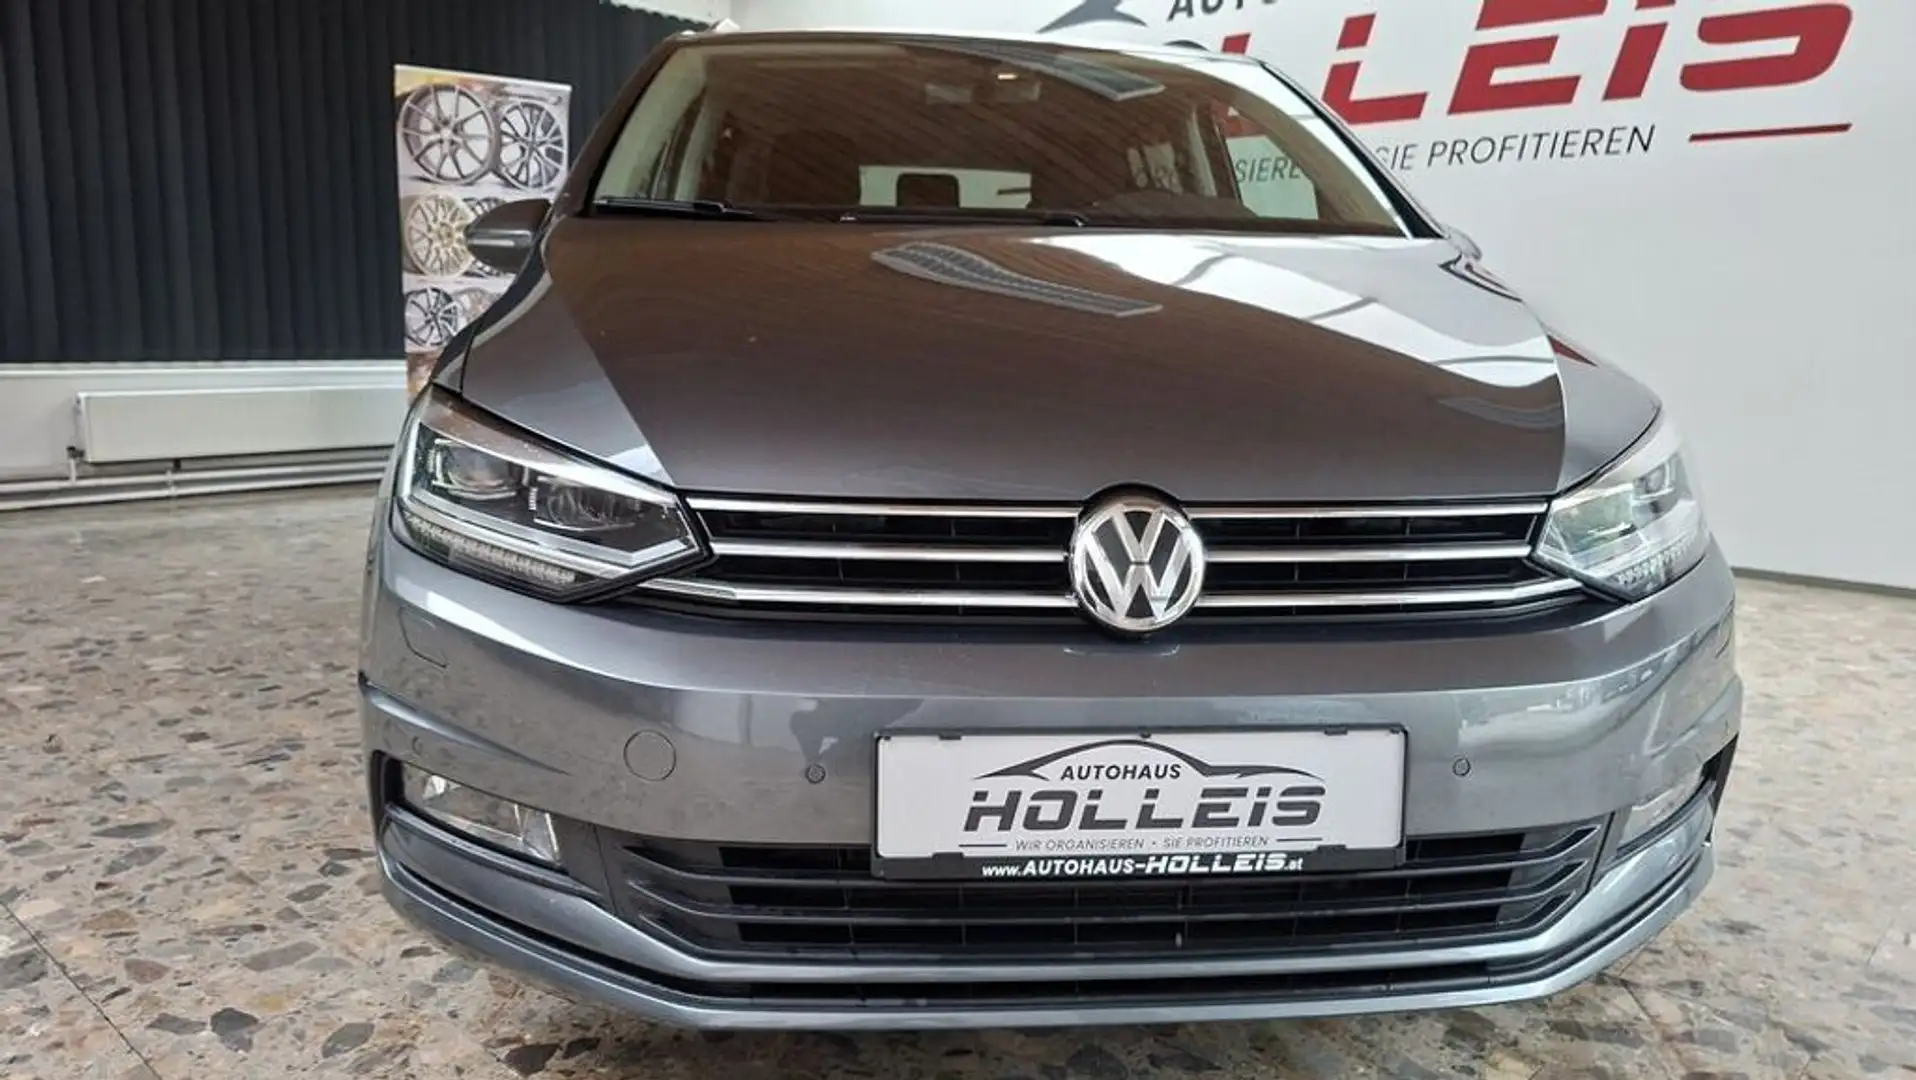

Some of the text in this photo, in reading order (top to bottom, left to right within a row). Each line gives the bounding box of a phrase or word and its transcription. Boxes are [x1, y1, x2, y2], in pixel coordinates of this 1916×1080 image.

[1427, 124, 1656, 168] PROFITIEREN
[1060, 763, 1182, 781] AUTOHAUS
[963, 785, 1326, 832] HOLLEIS
[1016, 836, 1269, 851] WIR ORGANISIEREN SIE PROFITIEREN
